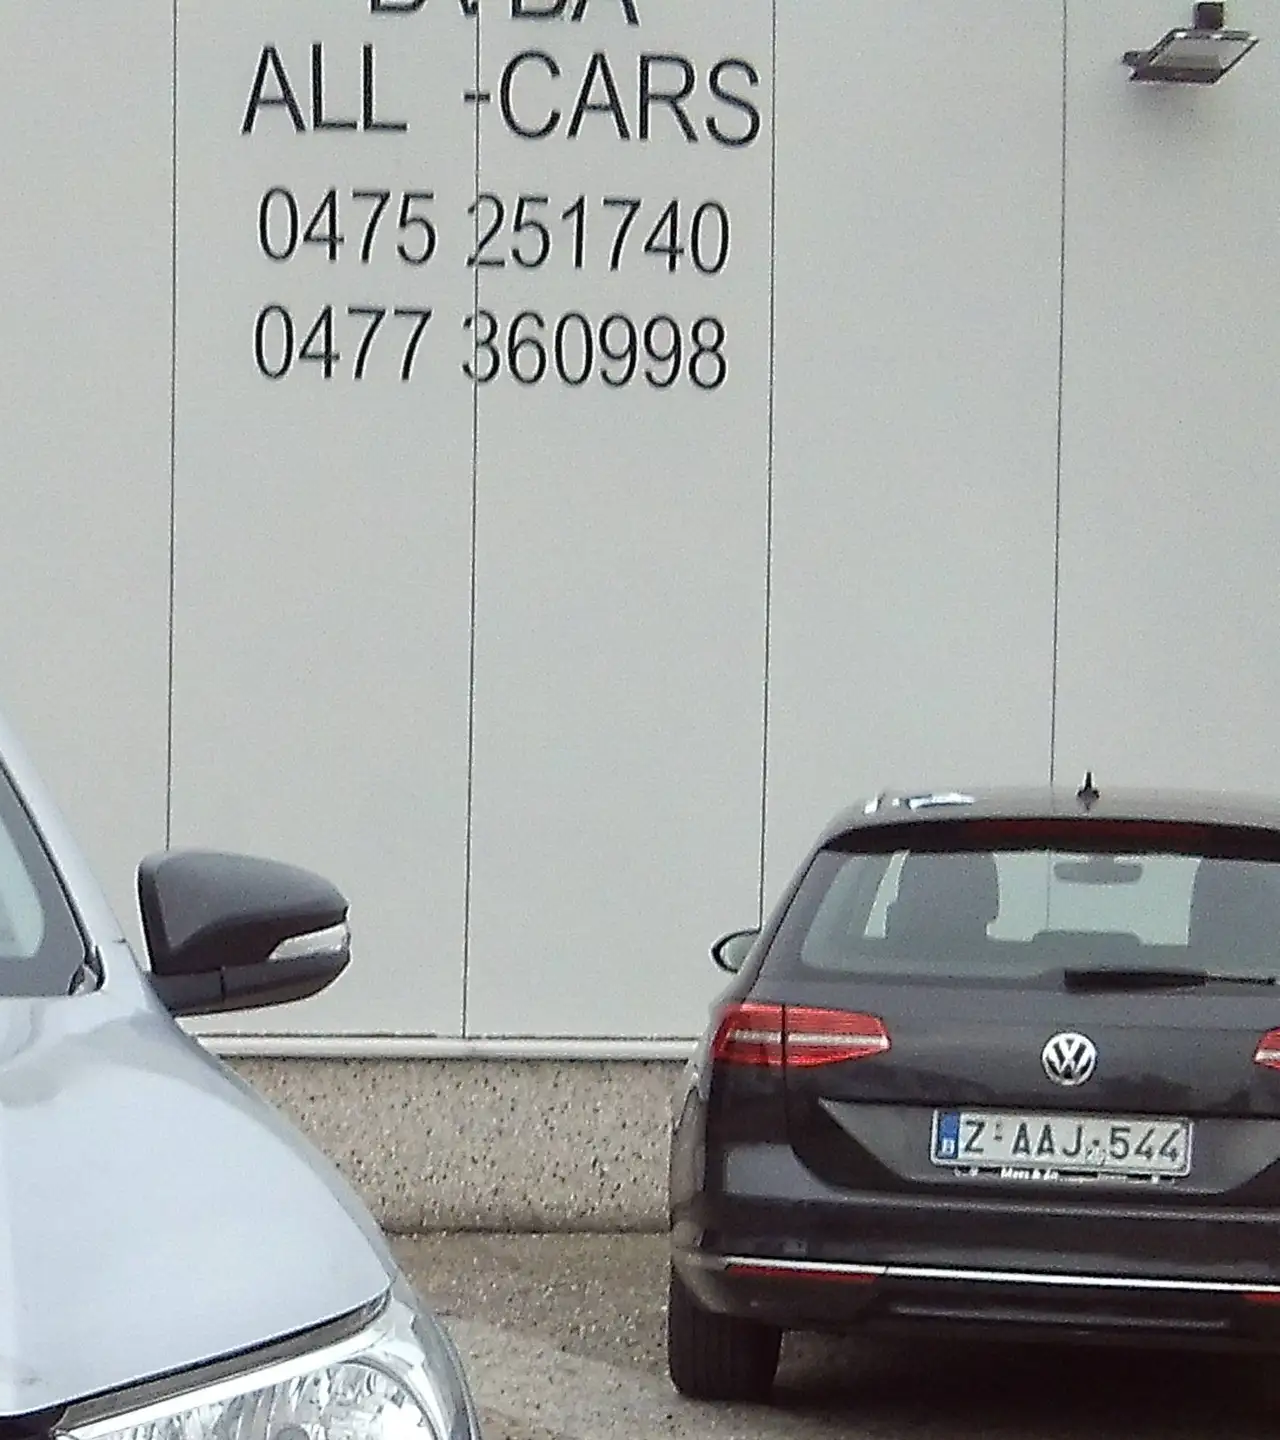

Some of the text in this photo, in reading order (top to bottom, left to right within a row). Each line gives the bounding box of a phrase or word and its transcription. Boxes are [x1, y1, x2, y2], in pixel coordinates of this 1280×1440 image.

[241, 42, 408, 135] ALL
[258, 186, 730, 275] 0475 251740
[254, 304, 728, 390] 0477 360998
